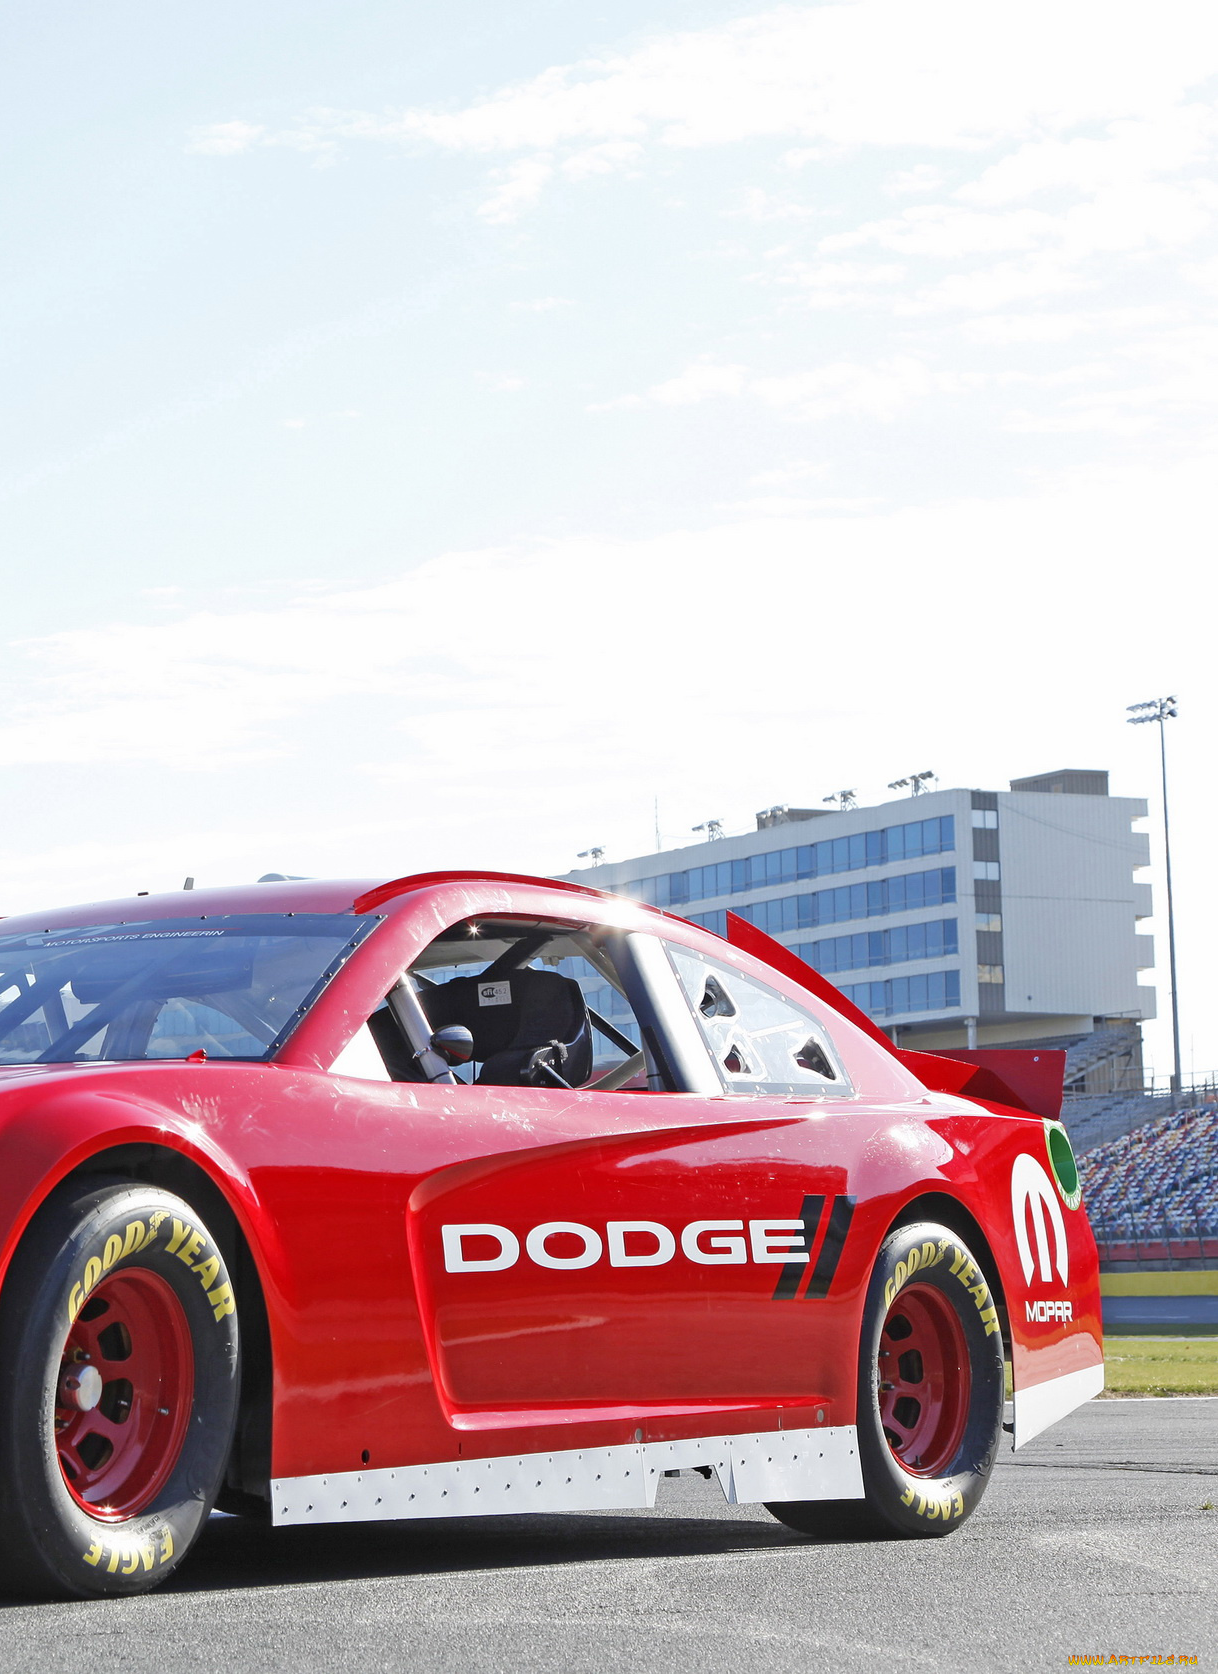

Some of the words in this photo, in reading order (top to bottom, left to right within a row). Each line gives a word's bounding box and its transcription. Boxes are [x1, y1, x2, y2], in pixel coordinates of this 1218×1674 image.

[441, 1220, 811, 1273] DODGE
[1025, 1300, 1073, 1323] MOPAR
[900, 1483, 964, 1521] EAGLE
[83, 1525, 174, 1575] EAGLE
